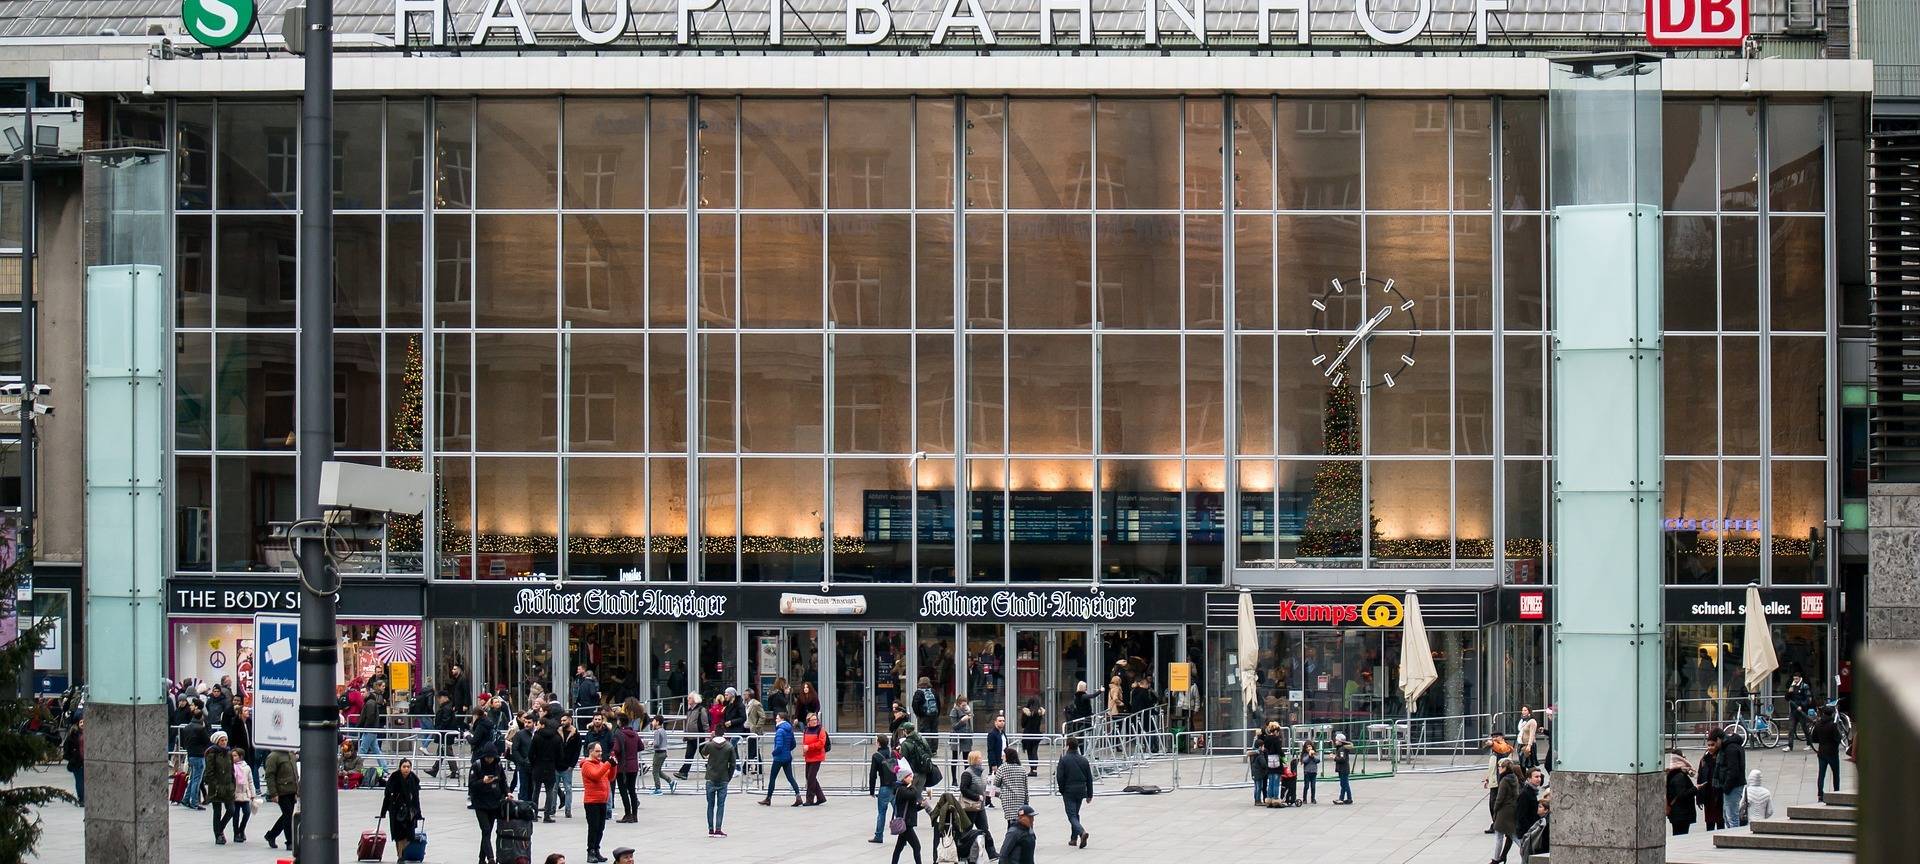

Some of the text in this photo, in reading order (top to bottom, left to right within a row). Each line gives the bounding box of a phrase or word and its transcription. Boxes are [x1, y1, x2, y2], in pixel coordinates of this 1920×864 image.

[196, 0, 238, 37] S
[1660, 0, 1735, 32] DB
[177, 590, 216, 608] THE
[224, 590, 280, 608] BODY
[514, 588, 727, 618] Kölner Stadt-Anzeiger
[919, 590, 1137, 619] Kölner Stadt-Anzeiger
[1520, 595, 1543, 612] EXPRESS
[1691, 601, 1735, 615] schnell.
[1801, 595, 1823, 611] EXPRESS
[1279, 600, 1358, 626] Kamps
